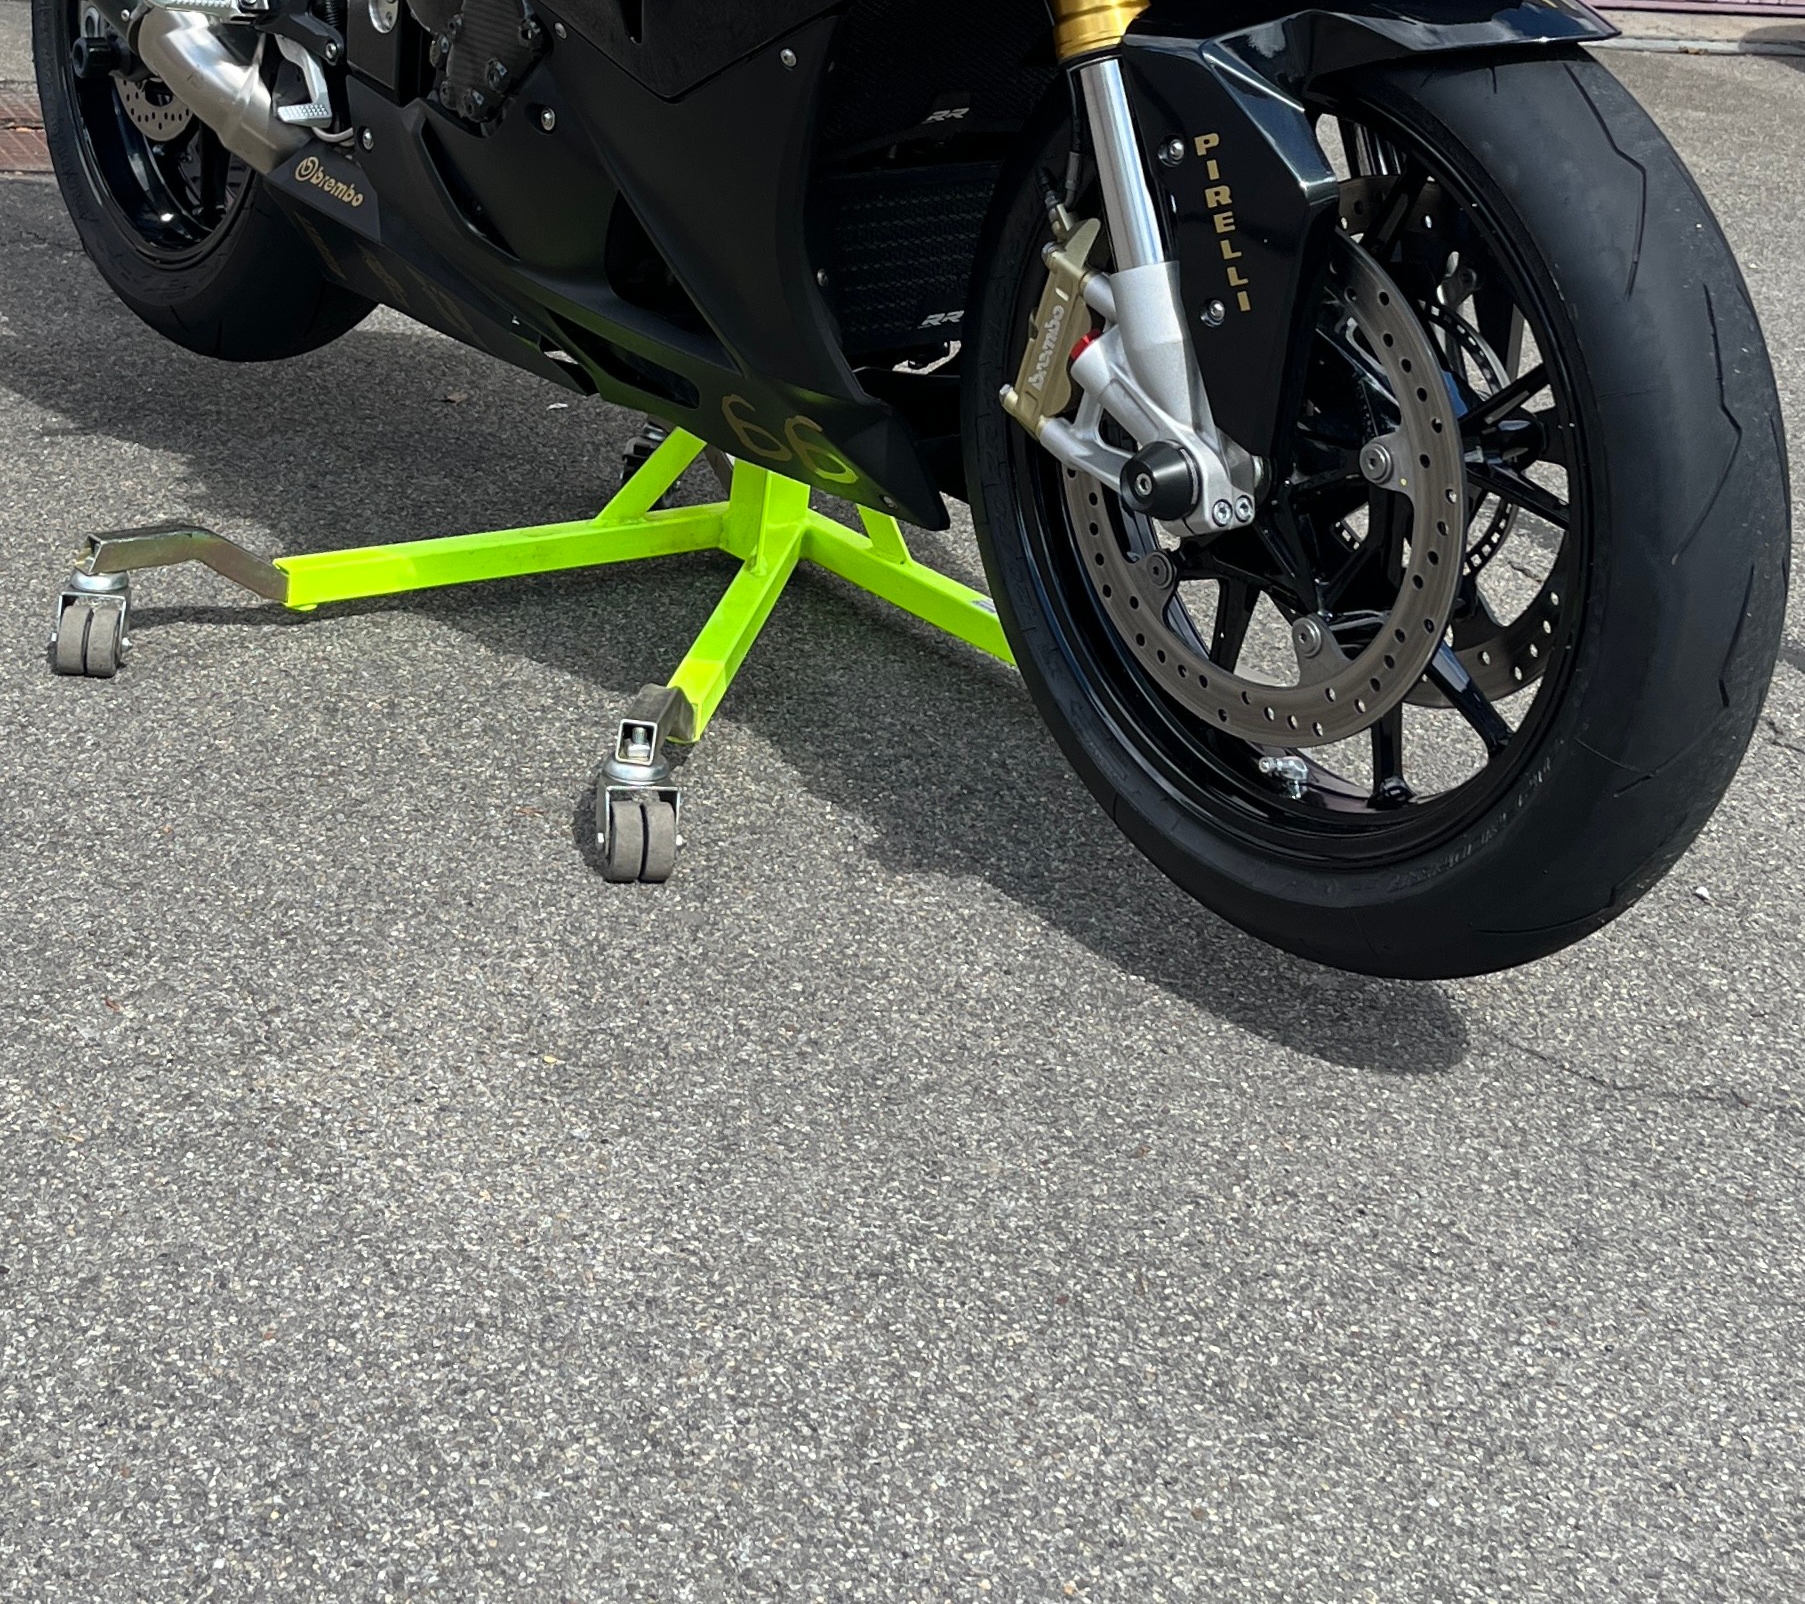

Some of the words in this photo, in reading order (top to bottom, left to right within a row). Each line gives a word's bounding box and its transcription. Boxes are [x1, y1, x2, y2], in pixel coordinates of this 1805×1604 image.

[925, 107, 970, 122] RR
[309, 165, 364, 207] brembo
[1194, 132, 1251, 312] PIRELLI
[920, 309, 965, 326] RR
[1027, 304, 1065, 392] brembo
[721, 393, 860, 484] 66
